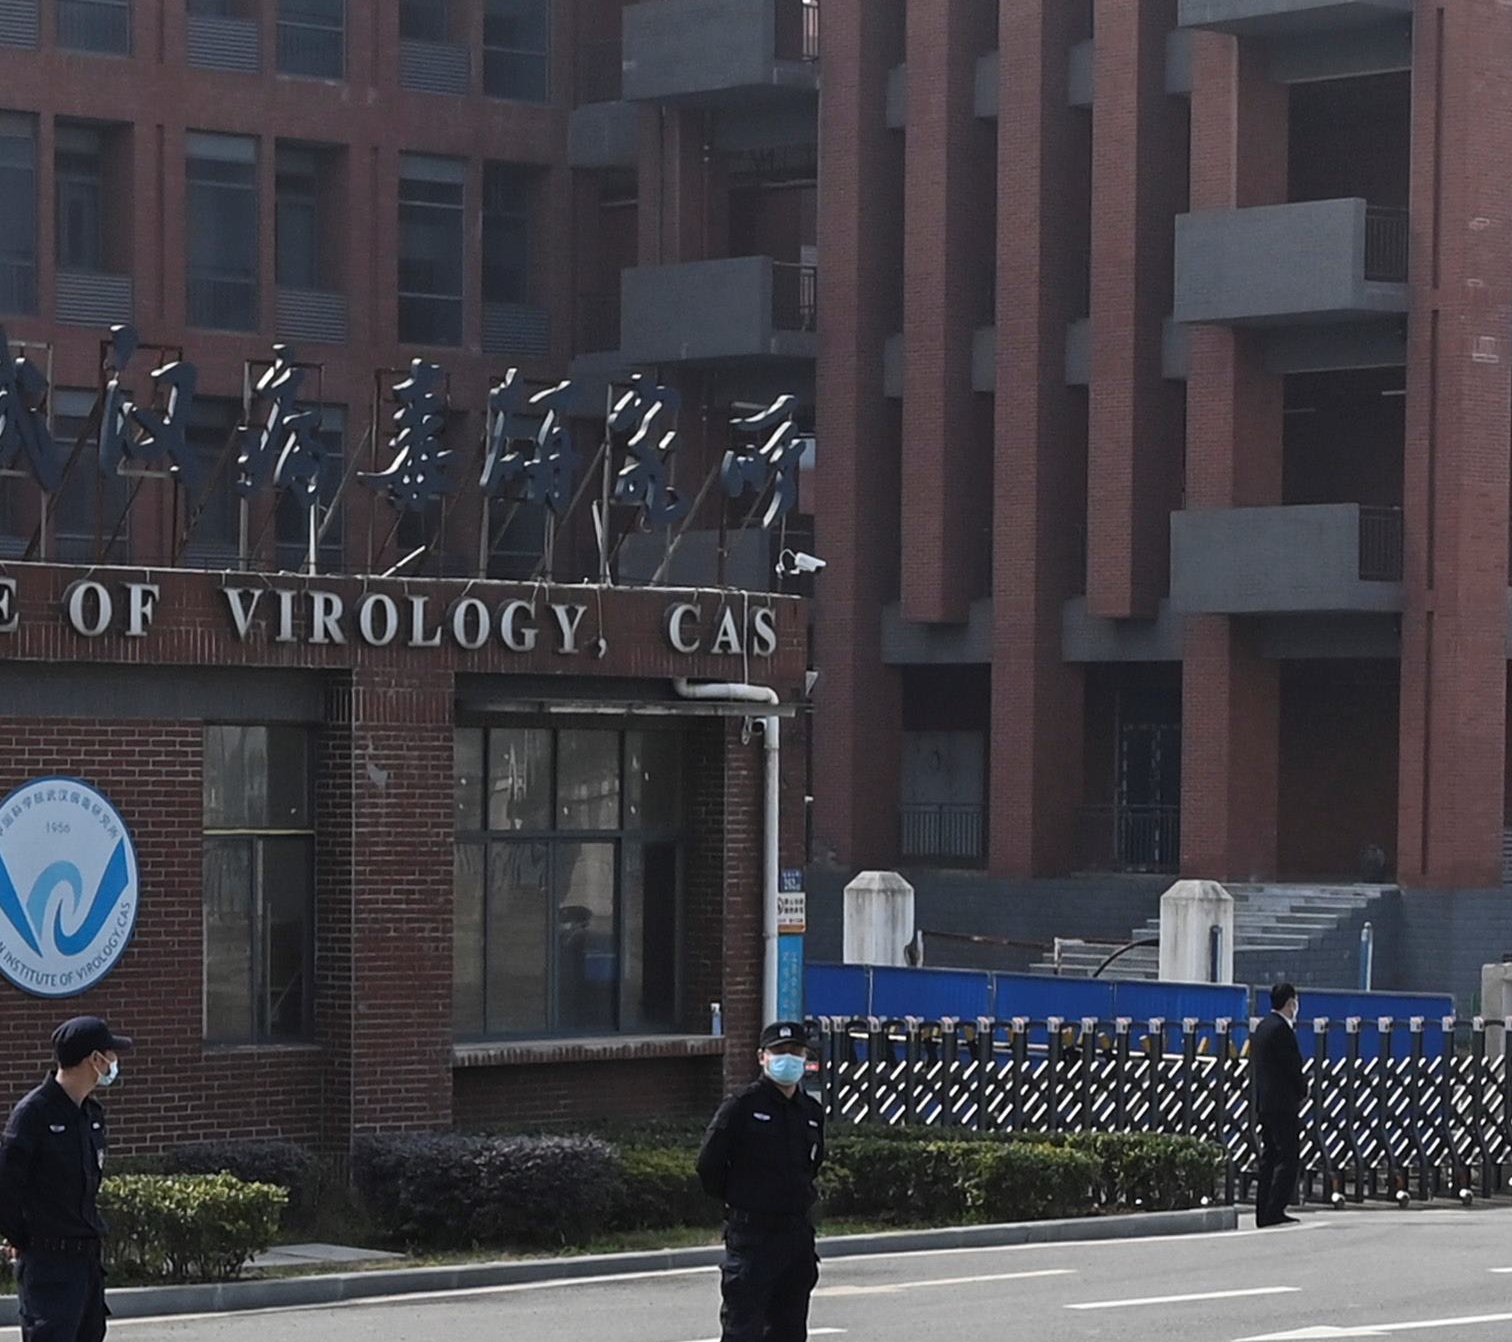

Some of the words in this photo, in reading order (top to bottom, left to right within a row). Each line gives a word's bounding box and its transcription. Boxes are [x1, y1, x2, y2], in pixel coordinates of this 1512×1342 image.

[62, 579, 160, 639] OF
[222, 586, 609, 660] VIROLOGY,
[667, 601, 779, 657] CAS
[45, 820, 71, 834] 1956
[3, 949, 57, 988] INSTITUTE
[59, 970, 75, 987] OF
